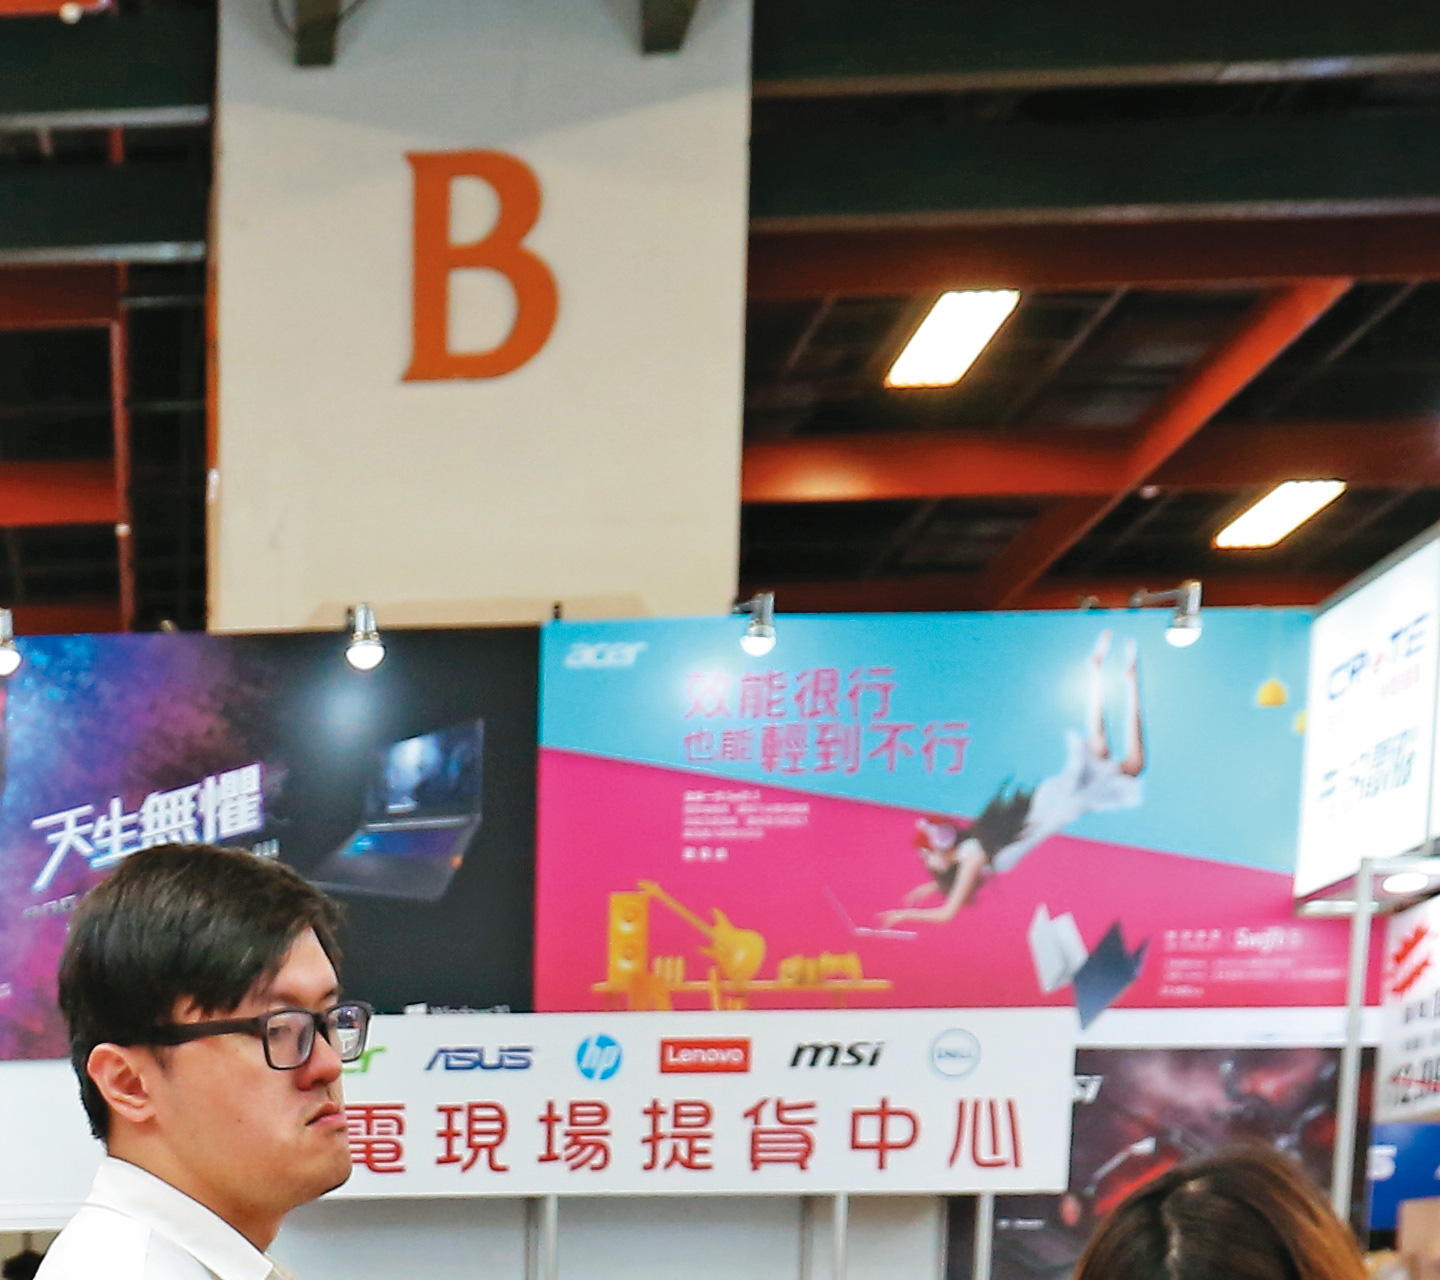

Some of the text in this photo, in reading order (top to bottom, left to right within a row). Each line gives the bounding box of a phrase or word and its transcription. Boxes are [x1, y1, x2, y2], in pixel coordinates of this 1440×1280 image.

[401, 149, 558, 384] B
[683, 721, 970, 775] 也能輕到不行
[425, 1045, 534, 1071] ASUS
[576, 1034, 622, 1081] hp
[663, 1044, 746, 1066] Lenovo
[790, 1040, 885, 1069] msi
[349, 1096, 1022, 1174] 電現場提貨中心
